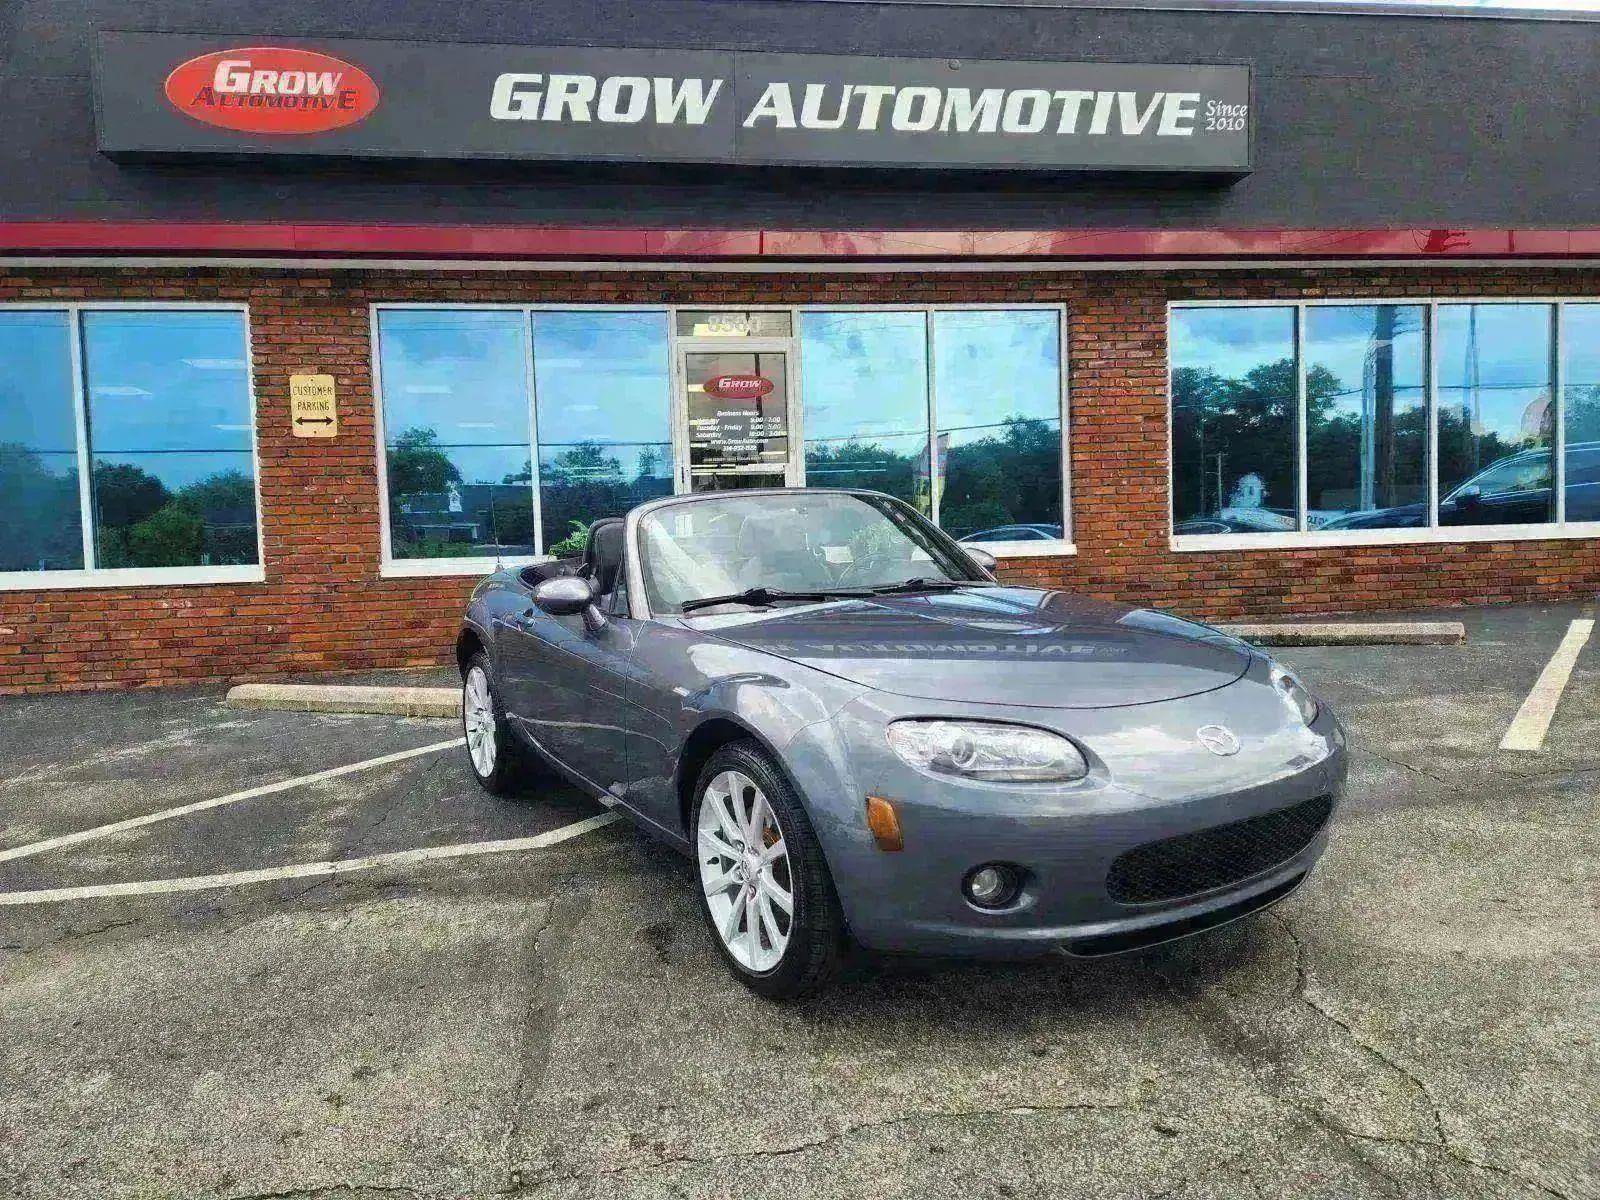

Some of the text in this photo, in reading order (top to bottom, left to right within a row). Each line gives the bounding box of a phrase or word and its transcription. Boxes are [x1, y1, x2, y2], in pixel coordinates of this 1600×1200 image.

[213, 60, 343, 95] GROW
[190, 86, 357, 110] AUTOMOTIVE
[490, 73, 1201, 136] GROW AUTOMOTIVE
[1205, 100, 1248, 117] Since
[1205, 117, 1245, 131] 2010
[718, 378, 762, 388] GROW
[293, 386, 333, 396] CUSTOMER
[297, 401, 330, 411] PARKING
